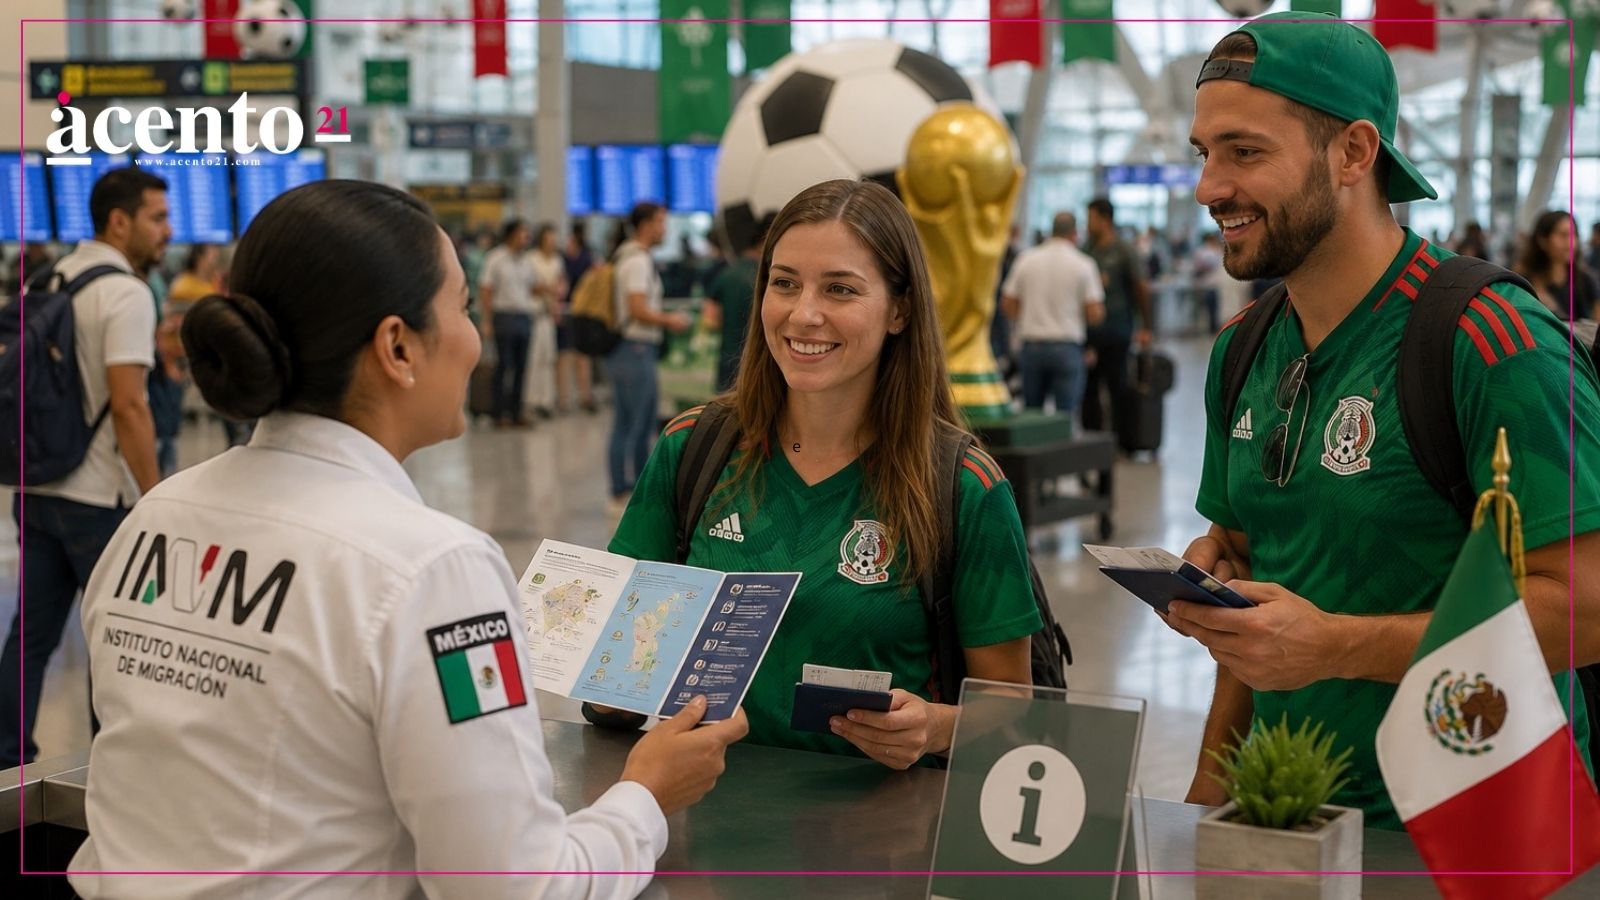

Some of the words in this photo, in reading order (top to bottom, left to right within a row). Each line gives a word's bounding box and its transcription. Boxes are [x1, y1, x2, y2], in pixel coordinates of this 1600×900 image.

[103, 626, 174, 660] INSTITUTO
[176, 644, 267, 685] NACIONAL
[433, 619, 508, 653] MÉXICO
[117, 654, 136, 675] DE
[137, 661, 228, 698] MIGRACIÓN
